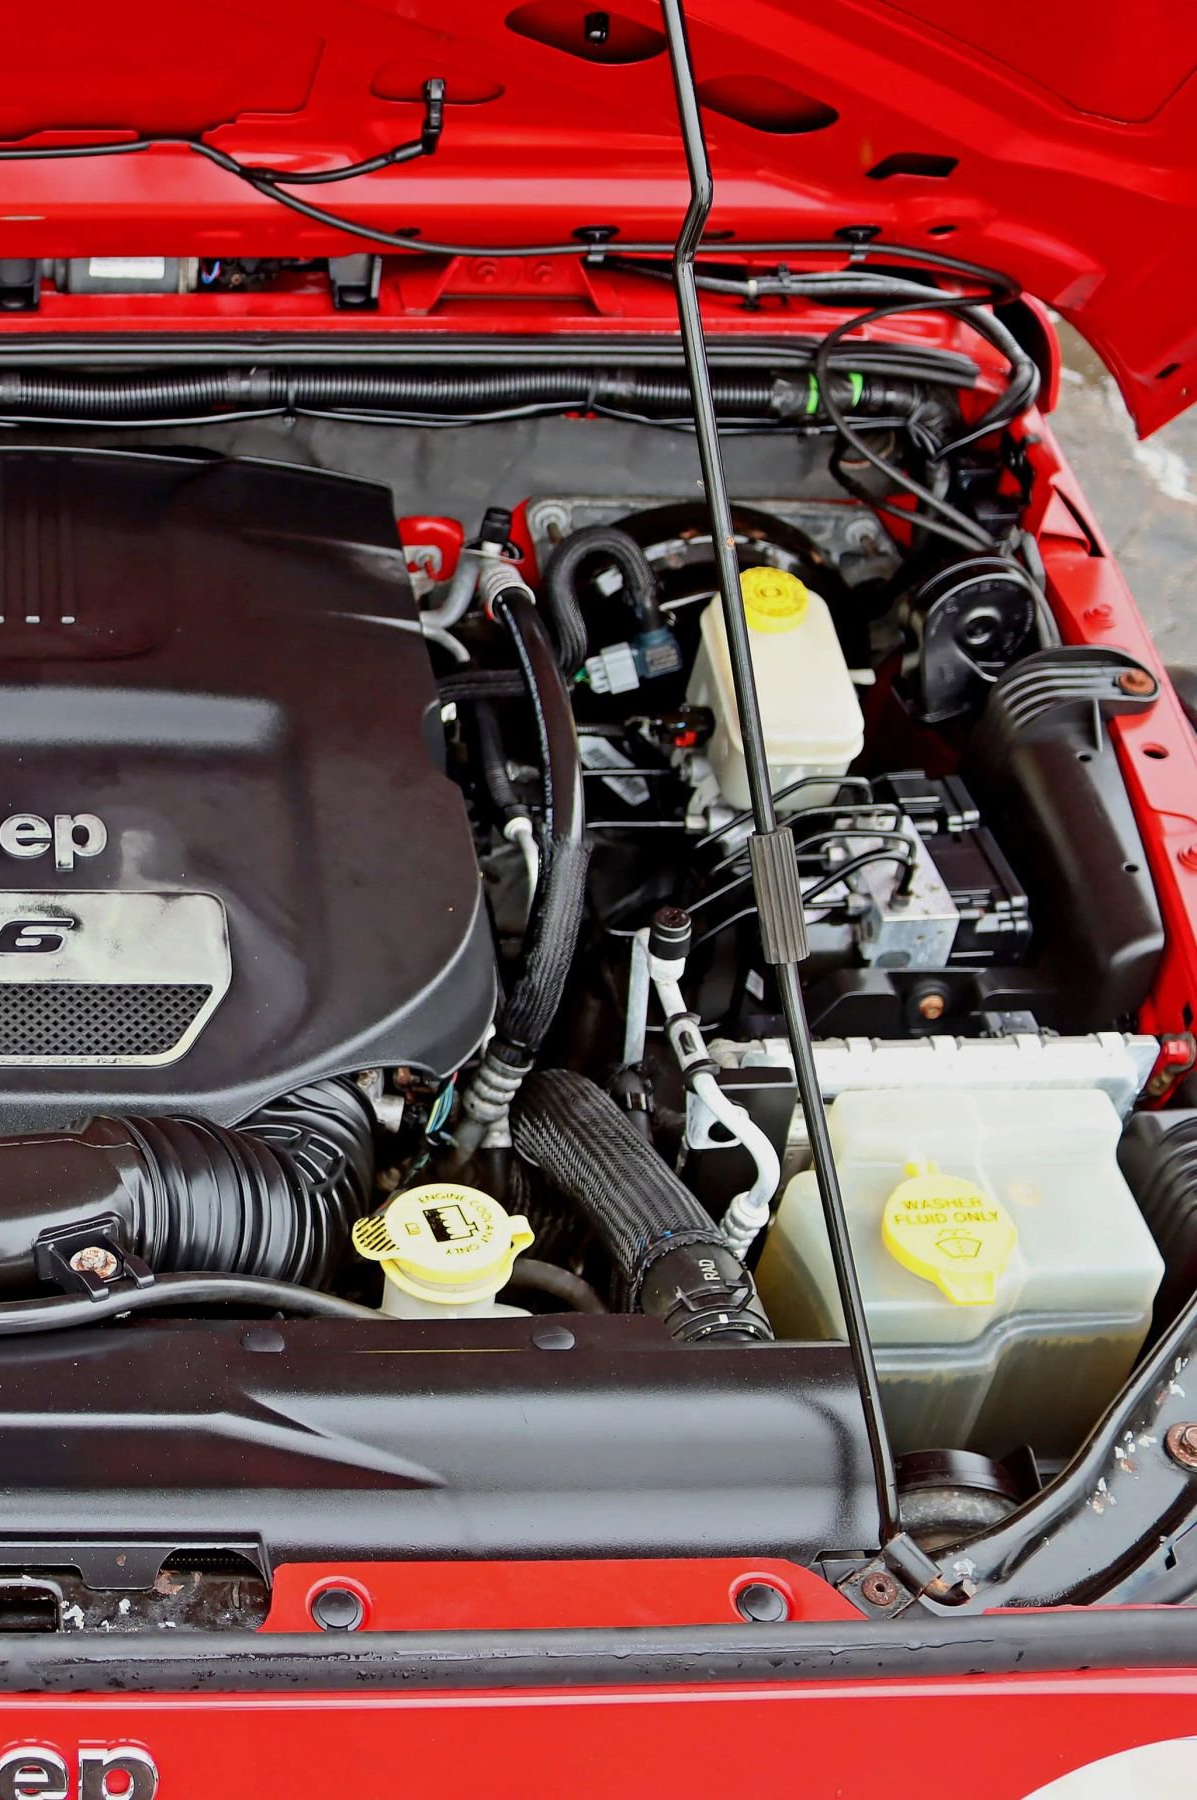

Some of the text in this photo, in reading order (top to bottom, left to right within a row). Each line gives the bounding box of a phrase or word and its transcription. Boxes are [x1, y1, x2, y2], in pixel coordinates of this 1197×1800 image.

[902, 1197, 983, 1210] WASHER
[418, 1192, 495, 1256] ENGINE COOLANT ONLY
[894, 1210, 999, 1225] FLUID ONLY
[698, 1259, 721, 1281] RAD
